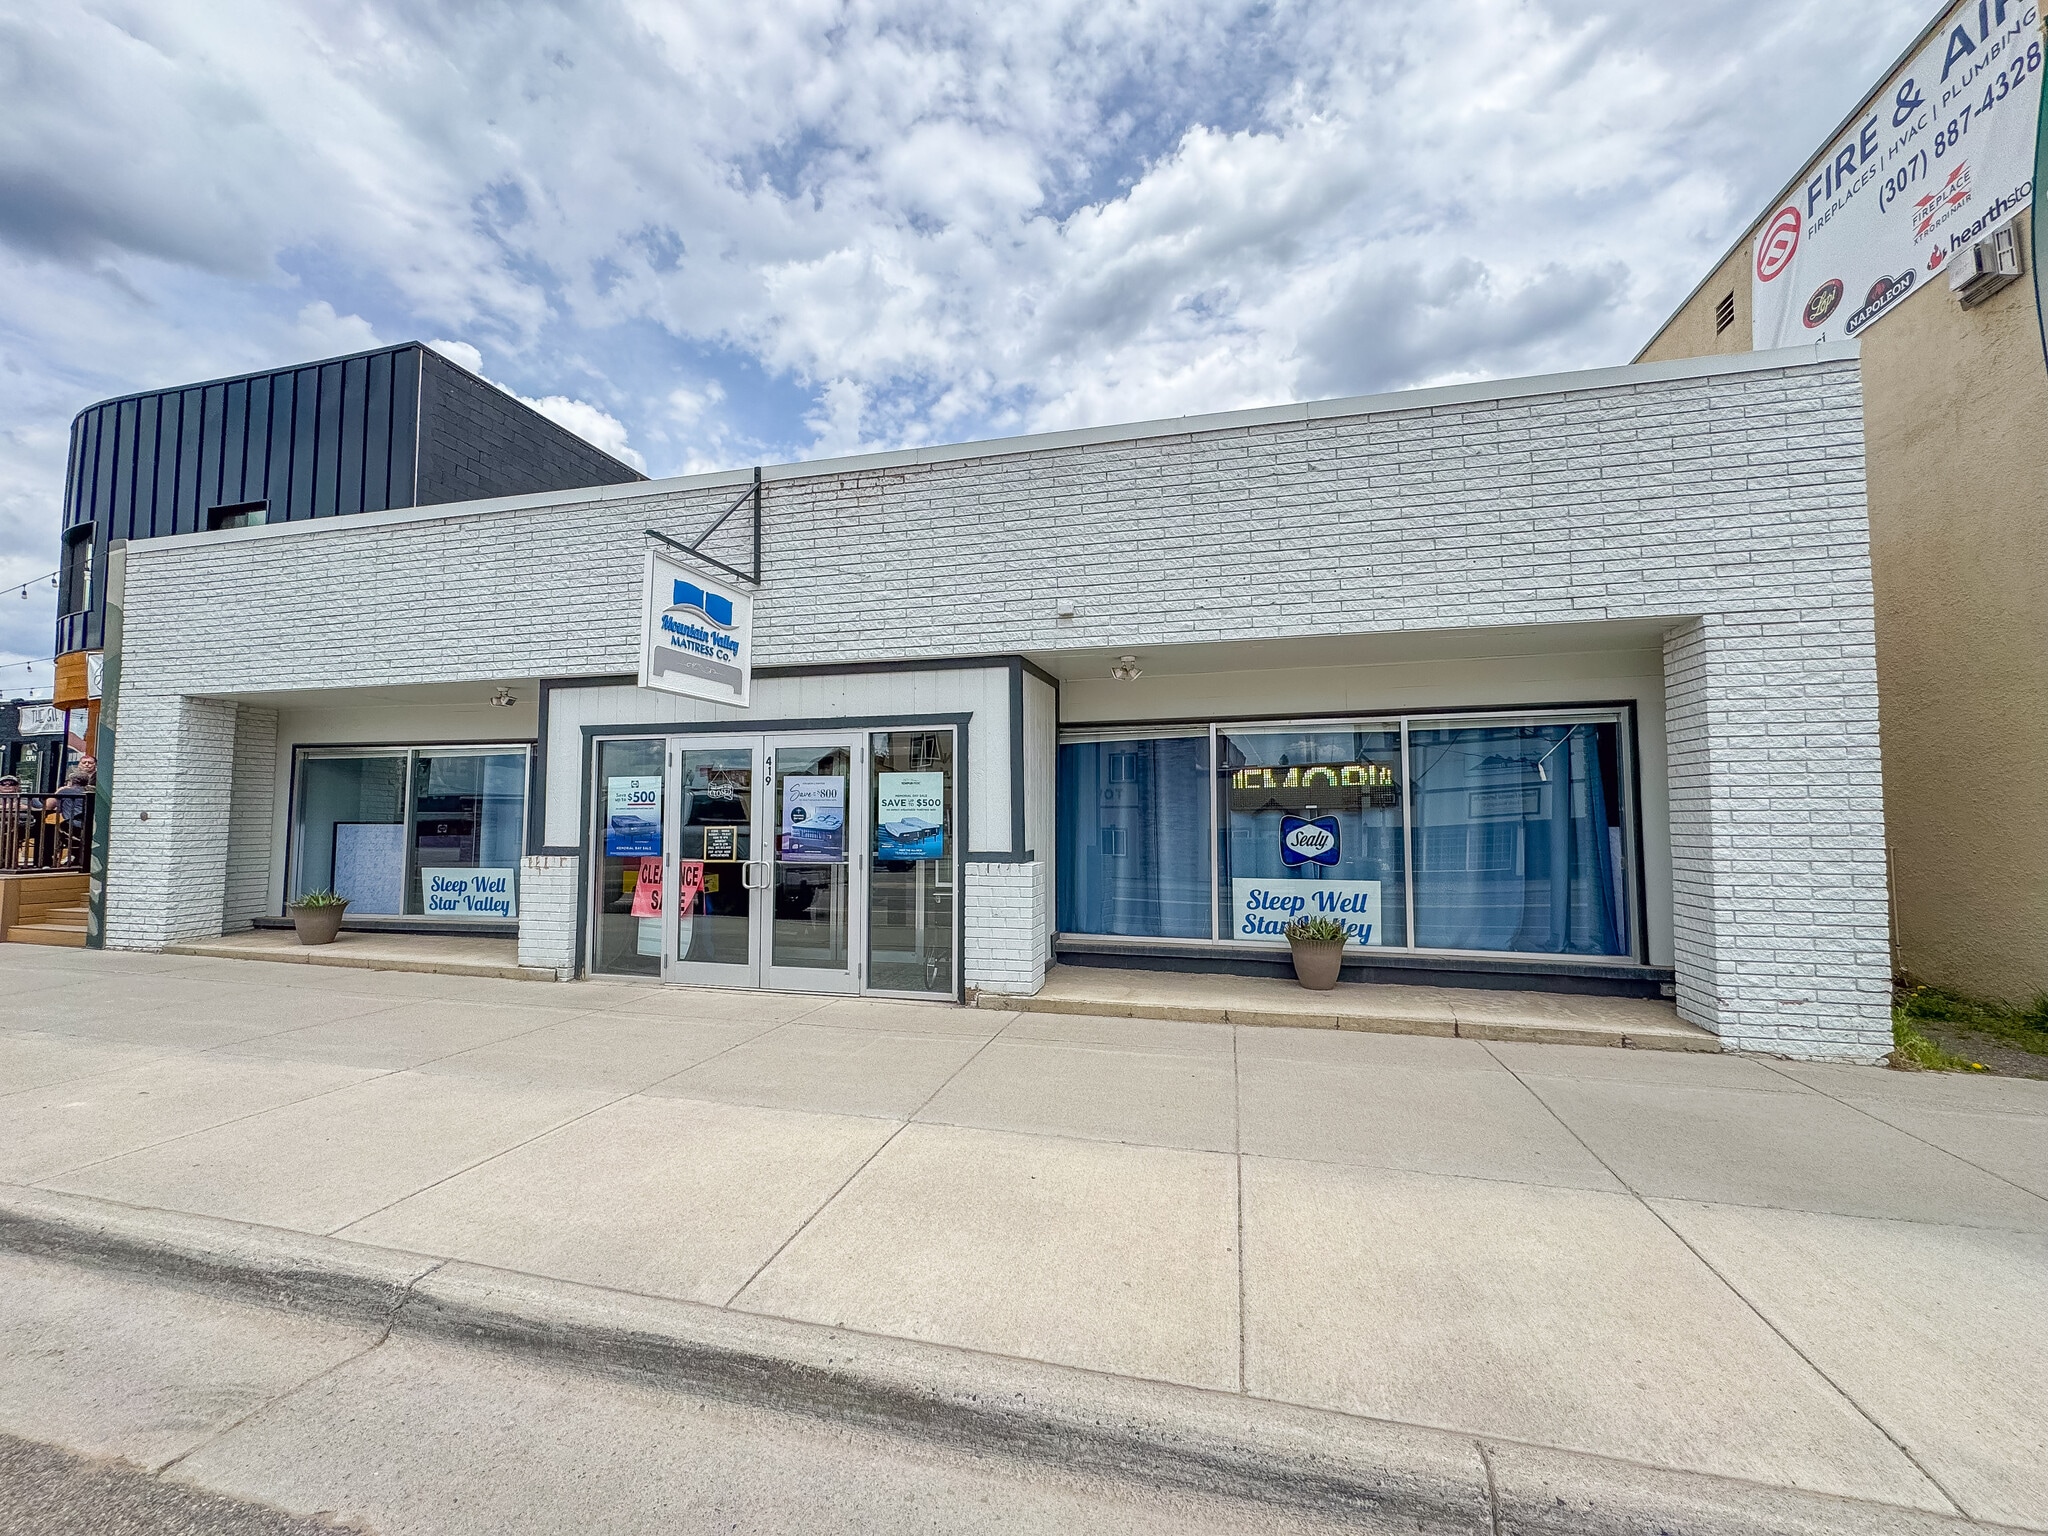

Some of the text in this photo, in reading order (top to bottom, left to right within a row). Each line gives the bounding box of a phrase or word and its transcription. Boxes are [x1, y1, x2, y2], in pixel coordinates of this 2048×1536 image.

[1808, 164, 1876, 240] FIREPLACES
[1888, 113, 1928, 160] HVAC
[1942, 6, 2036, 108] PLUMBING
[1879, 41, 2042, 214] (307) 887-4328
[1807, 114, 1879, 219] FIRE
[1892, 78, 1926, 128] &
[1912, 170, 1971, 227] FIREPLACE
[1913, 194, 1972, 246] XTRORDINAIR
[1950, 181, 2032, 252] hearthsto
[1809, 286, 1837, 321] Lopi
[1849, 275, 1912, 330] NAPOLEON
[661, 614, 739, 657] Mountain Valley
[671, 635, 714, 656] MATTRESS
[627, 790, 656, 803] $500
[789, 783, 812, 802] Save
[881, 798, 941, 807] SAVE $500
[1290, 830, 1329, 850] Sealy
[431, 875, 506, 897] Sleep Well
[641, 864, 699, 887] CLECE
[429, 894, 510, 917] Star Valley
[1246, 889, 1368, 917] Sleep Well
[1241, 913, 1290, 935] Star
